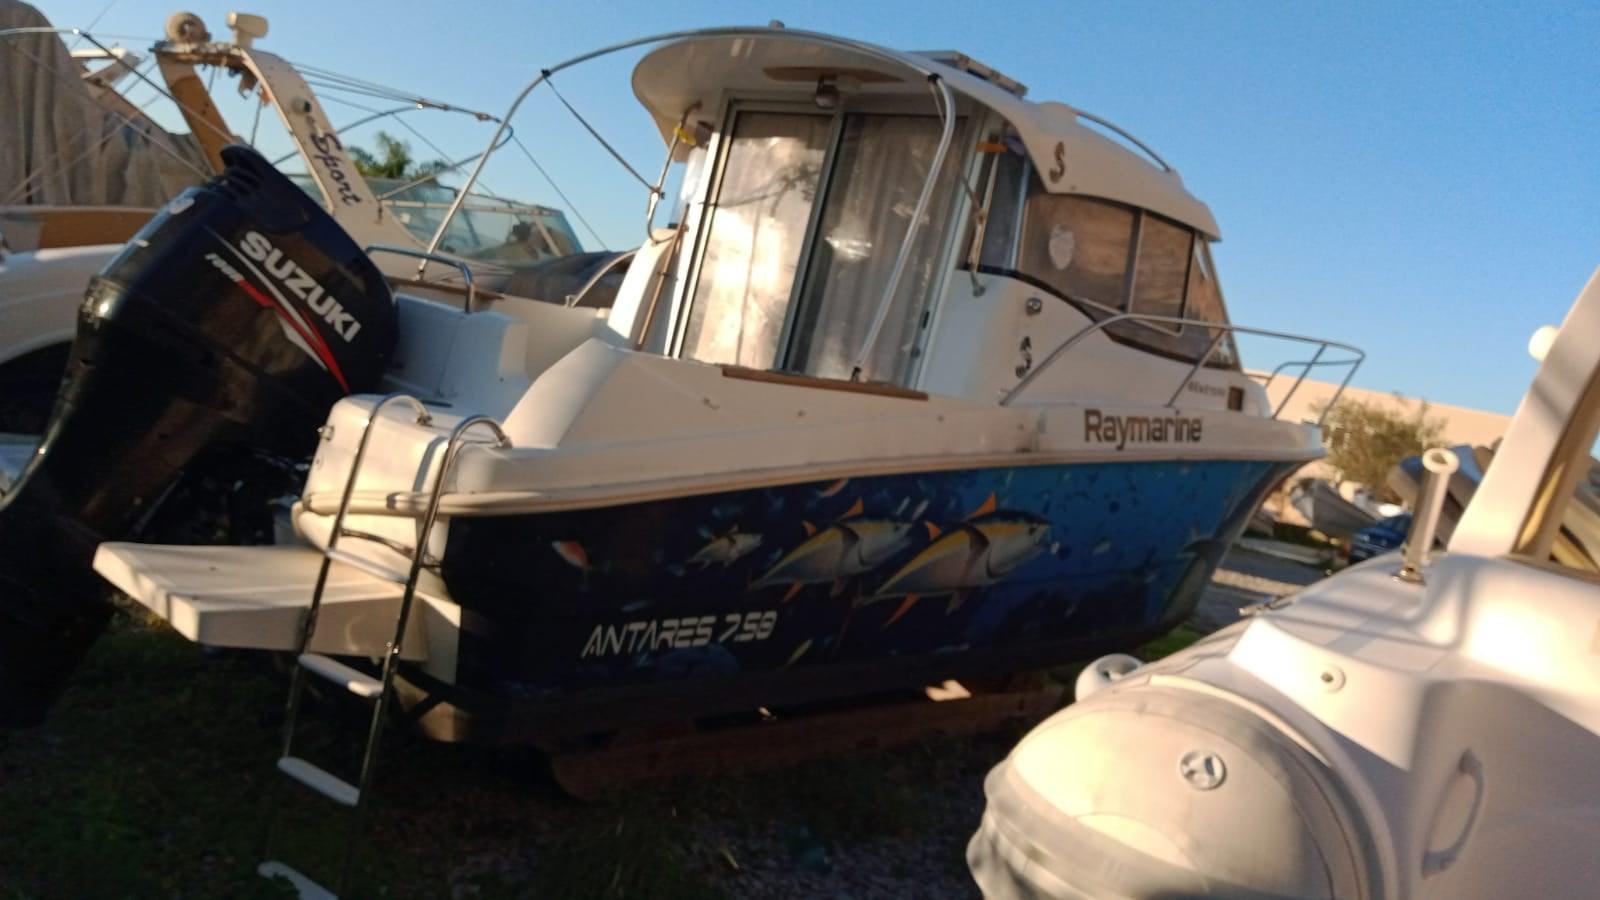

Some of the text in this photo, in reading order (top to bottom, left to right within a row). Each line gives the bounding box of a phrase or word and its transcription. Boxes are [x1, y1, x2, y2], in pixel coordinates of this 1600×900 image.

[310, 131, 361, 206] Sport
[240, 231, 361, 343] SUZUKI
[1084, 409, 1203, 450] Raymarine
[580, 616, 717, 659] ANTARES
